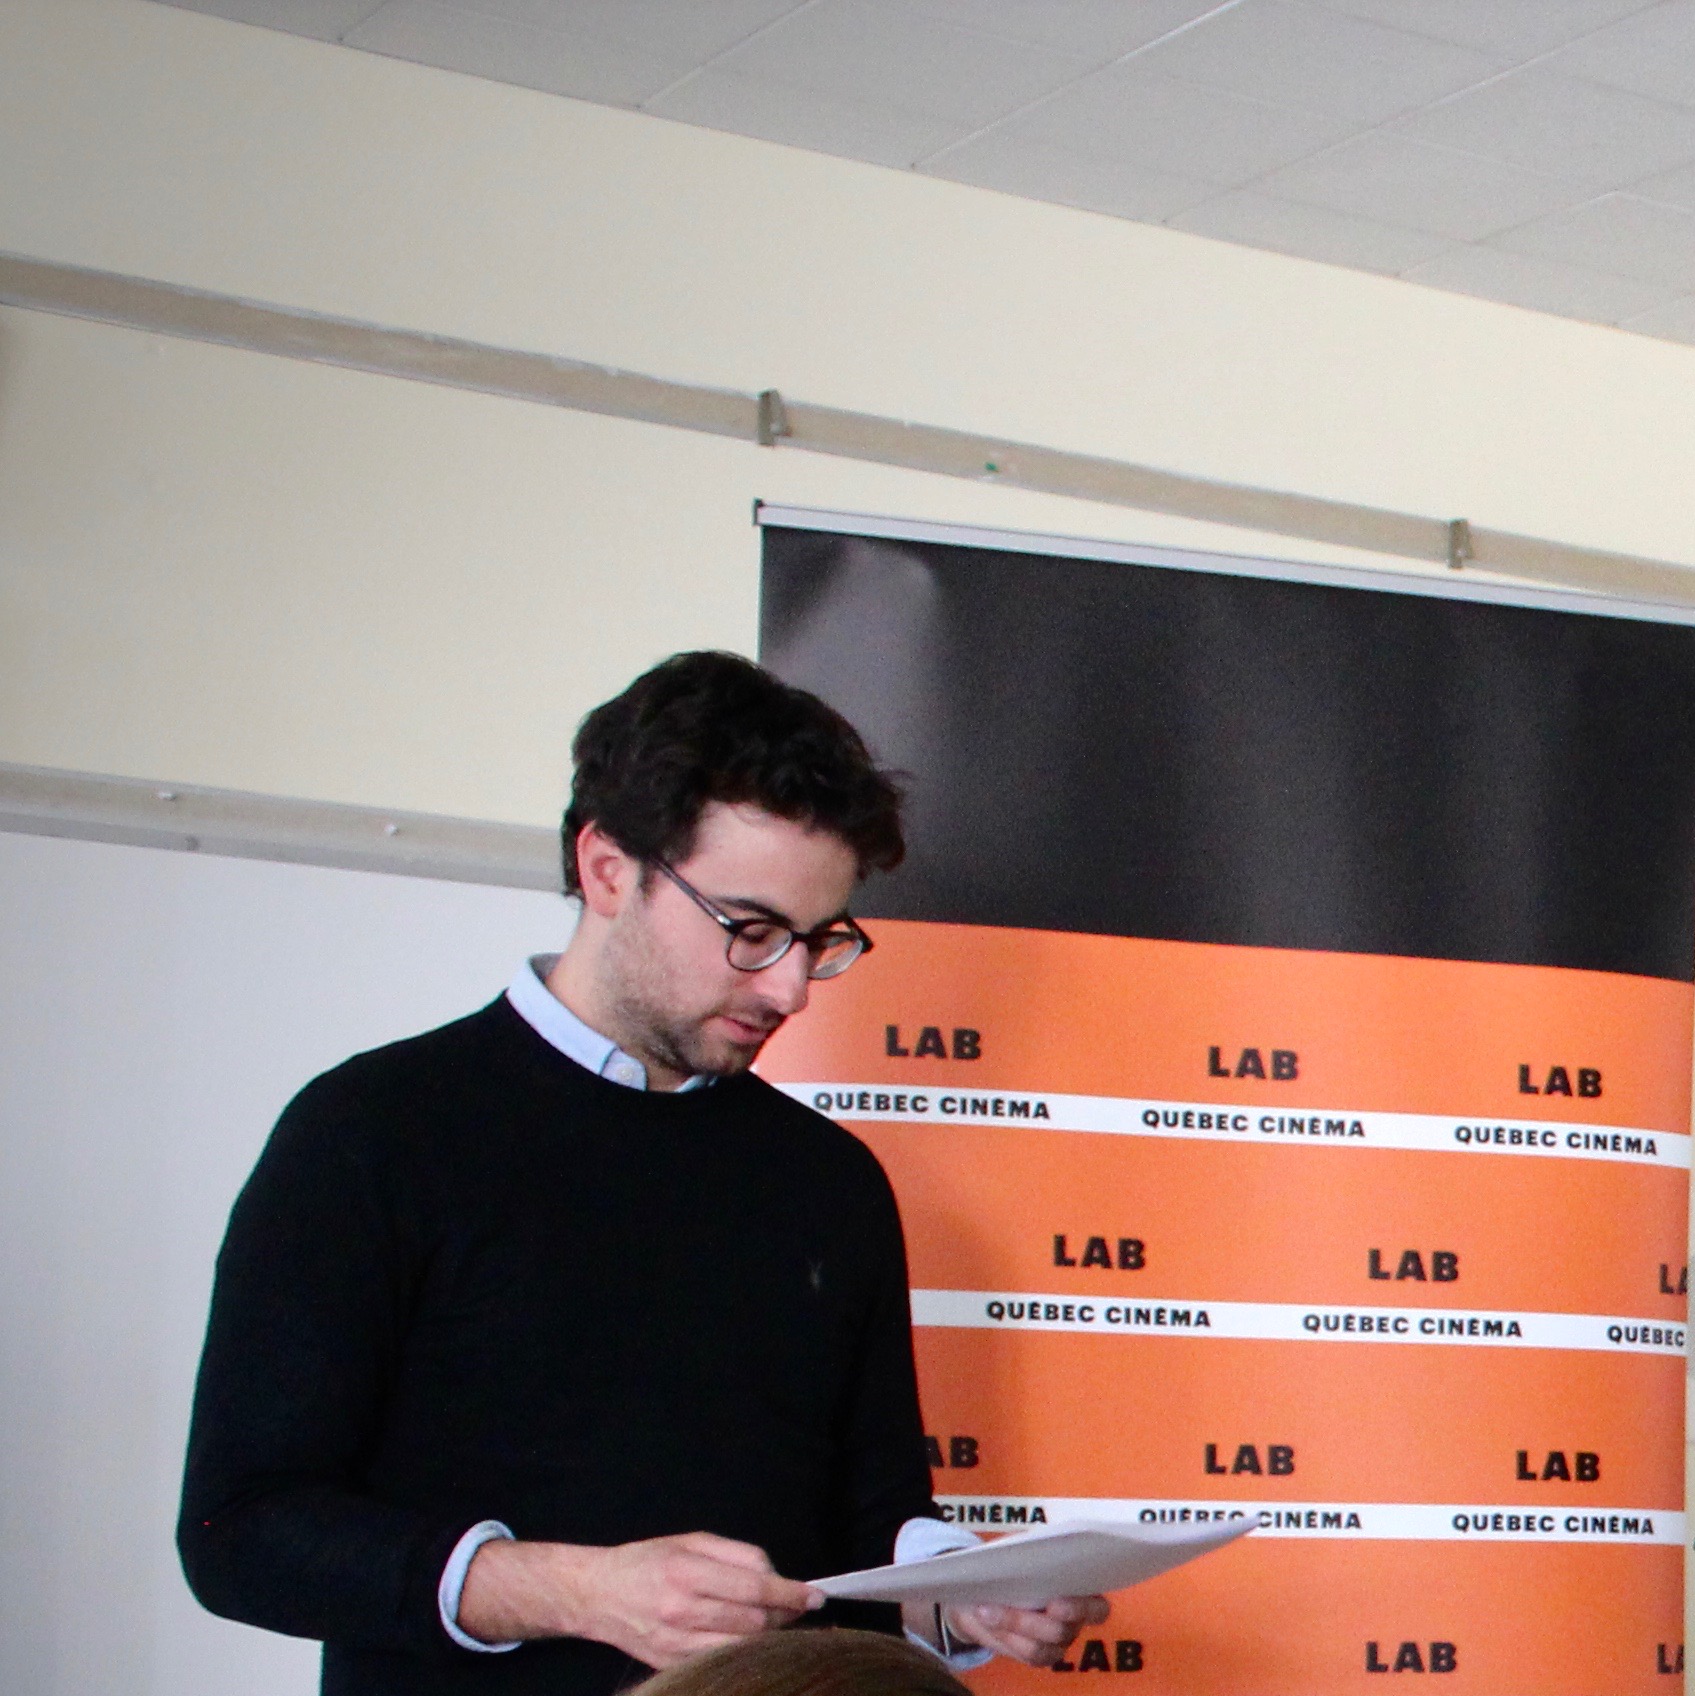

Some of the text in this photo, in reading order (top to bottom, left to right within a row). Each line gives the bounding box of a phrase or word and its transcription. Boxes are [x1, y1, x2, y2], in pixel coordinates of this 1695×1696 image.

[886, 1025, 981, 1060] LAB
[1208, 1046, 1297, 1080] LAB
[1519, 1065, 1602, 1098] LAB
[813, 1091, 1049, 1119] QUÉBEC CINÉMA
[1141, 1109, 1364, 1137] QUÉBEC CINÉMA
[1454, 1126, 1656, 1155] QUÉBEC CINÉMA
[1054, 1235, 1144, 1270] LAB
[1369, 1249, 1458, 1282] LAB
[985, 1300, 1209, 1326] QUÉBEC CINÉMA
[1303, 1314, 1521, 1337] QUÉBEC CINÉMA
[1607, 1325, 1685, 1348] QUÉBEC
[924, 1436, 979, 1468] AB
[1205, 1444, 1294, 1475] LAB
[1517, 1451, 1599, 1482] LAB
[1452, 1513, 1653, 1534] QUÉBEC CINÉMA
[1366, 1642, 1456, 1673] LAB
